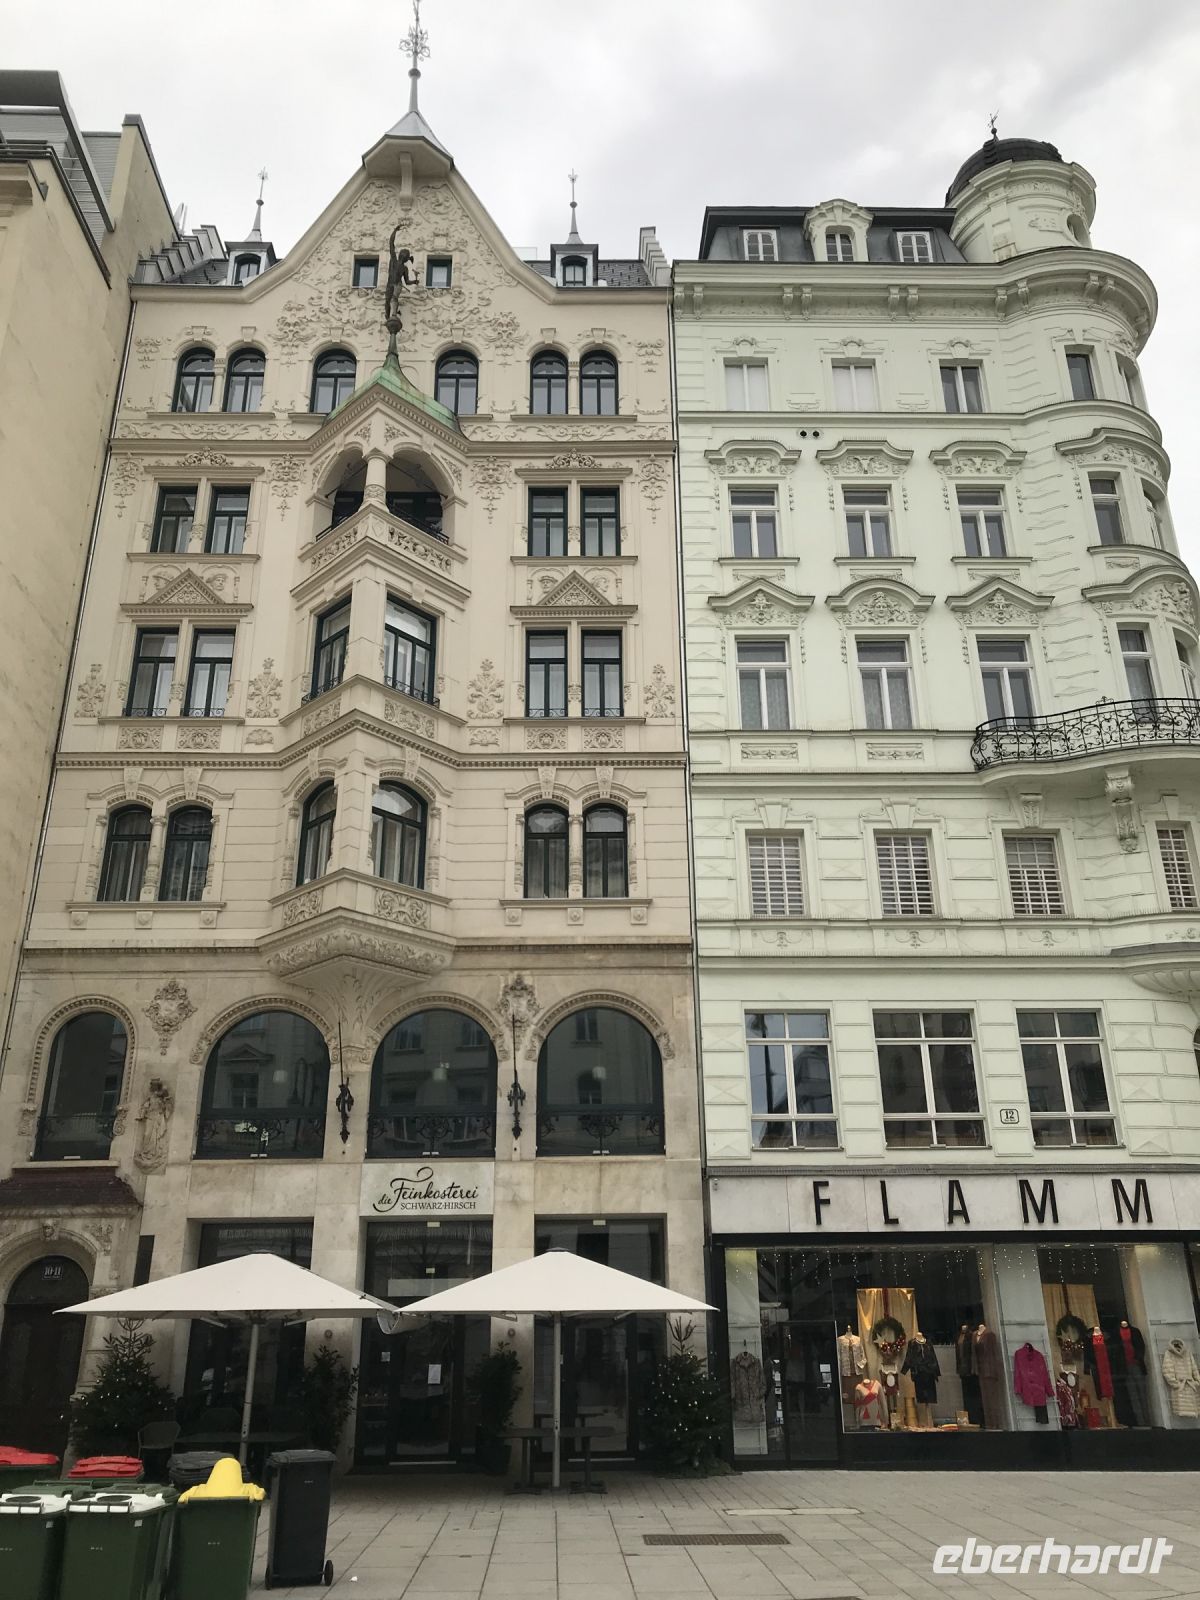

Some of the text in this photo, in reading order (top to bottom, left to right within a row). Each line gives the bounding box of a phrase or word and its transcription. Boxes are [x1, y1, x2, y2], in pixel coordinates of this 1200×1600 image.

[1005, 1110, 1015, 1119] 12
[373, 1166, 479, 1212] die Feinkosterei
[813, 1178, 1153, 1225] FLAMM
